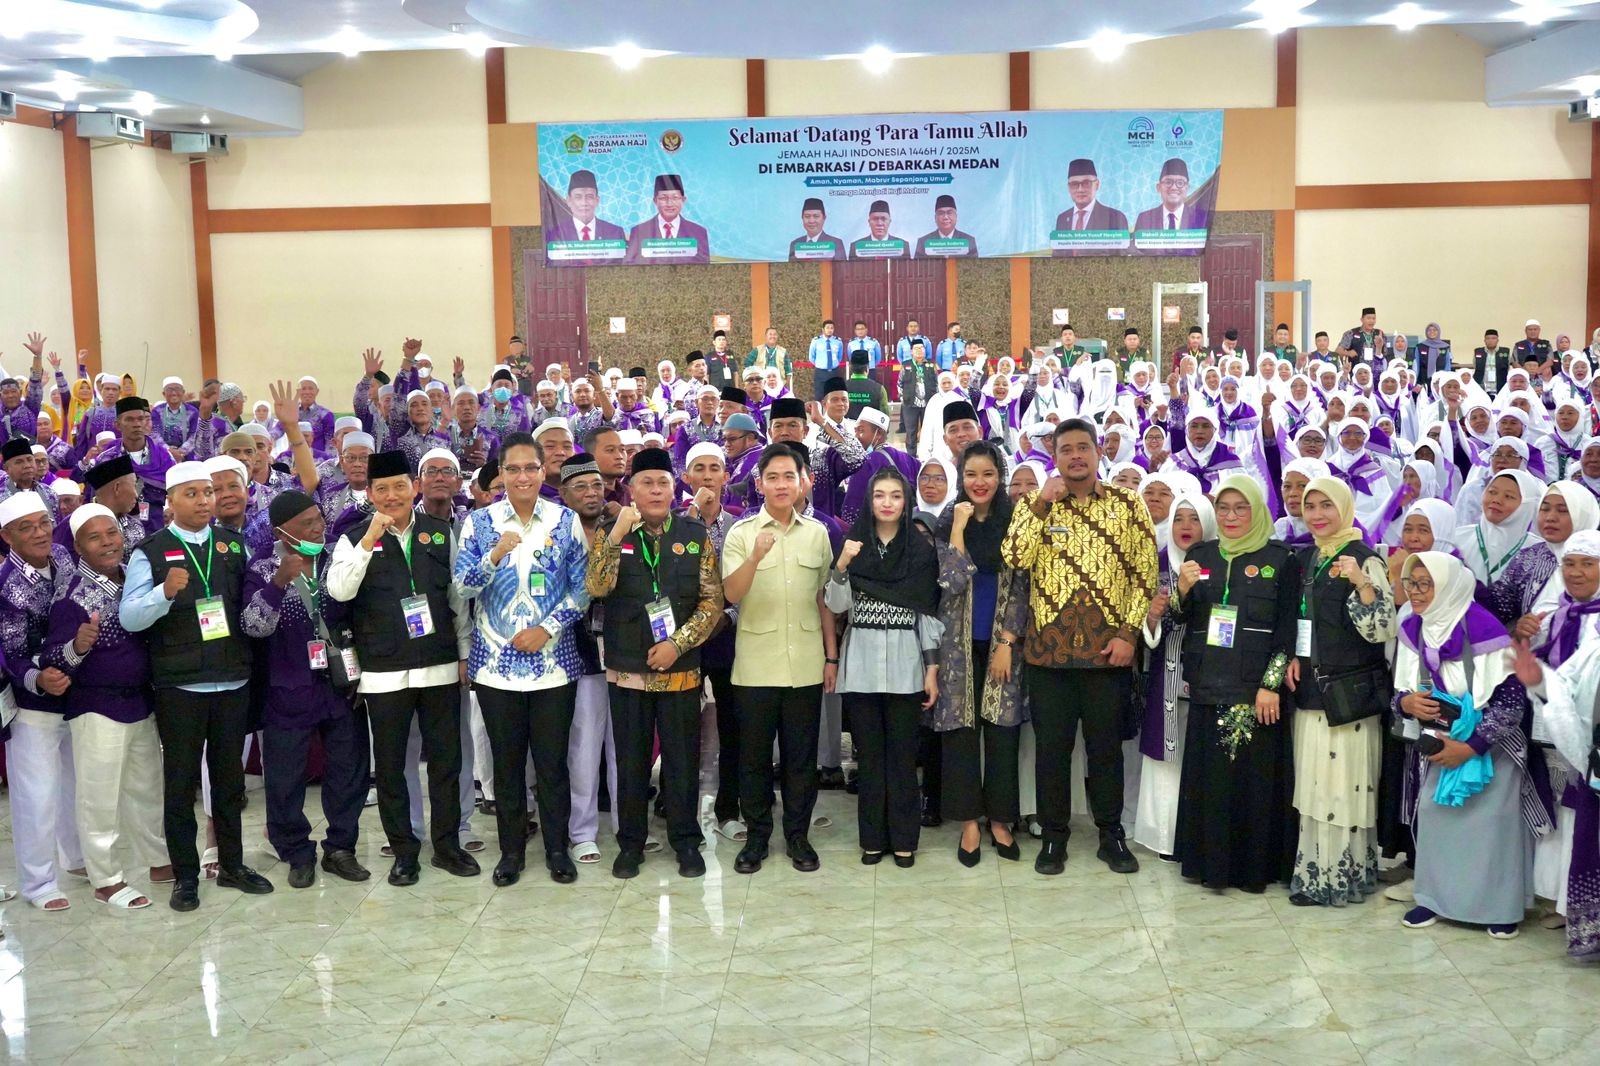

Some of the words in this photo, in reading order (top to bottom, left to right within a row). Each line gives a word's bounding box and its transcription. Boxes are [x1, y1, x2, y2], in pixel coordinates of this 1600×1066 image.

[729, 126, 800, 147] Selamat
[803, 125, 872, 146] Datang
[875, 123, 919, 141] Para
[923, 122, 974, 140] Tamu
[977, 120, 1028, 139] Allah
[1127, 131, 1155, 140] MCH
[587, 140, 625, 148] ASRAMA
[1165, 139, 1193, 148] pusaka
[777, 149, 821, 159] JEMAAH
[823, 149, 847, 158] HAJI
[850, 147, 907, 157] INDONESIA
[909, 146, 937, 156] 1446H
[946, 146, 980, 155] 2025M
[759, 163, 772, 174] DI
[776, 161, 856, 173] EMBARKASI
[858, 160, 866, 173] /
[868, 159, 945, 172] DEBARKASI
[949, 158, 1000, 169] MEDAN
[891, 176, 929, 184] Sepanjang
[888, 188, 902, 196] Haji
